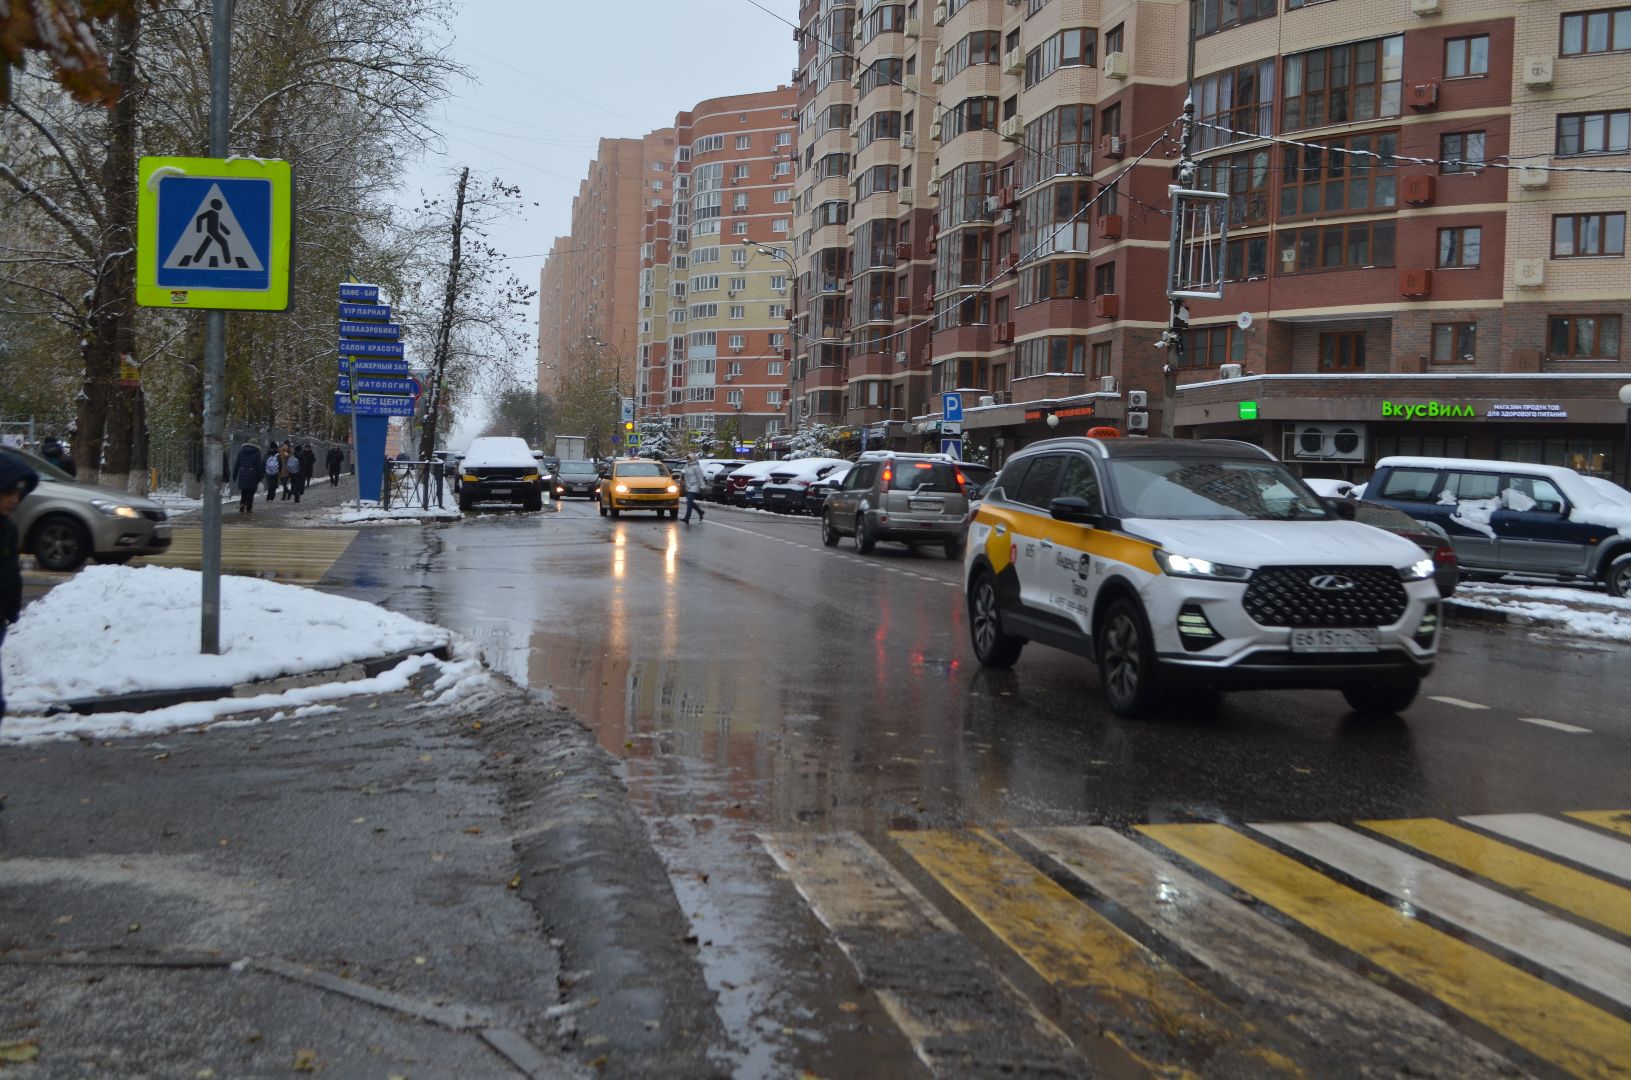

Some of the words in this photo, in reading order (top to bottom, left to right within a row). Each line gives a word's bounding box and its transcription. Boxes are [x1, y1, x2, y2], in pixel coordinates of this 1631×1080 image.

[357, 308, 387, 316] ПАРНАЯ
[341, 325, 398, 334] АКВААЭРОБИКА
[340, 343, 365, 351] САЛОН
[367, 344, 402, 352] КРАСОТЫ
[379, 397, 410, 407] ЦЕНТР
[946, 396, 959, 419] P
[1382, 400, 1475, 419] ВкусВилл
